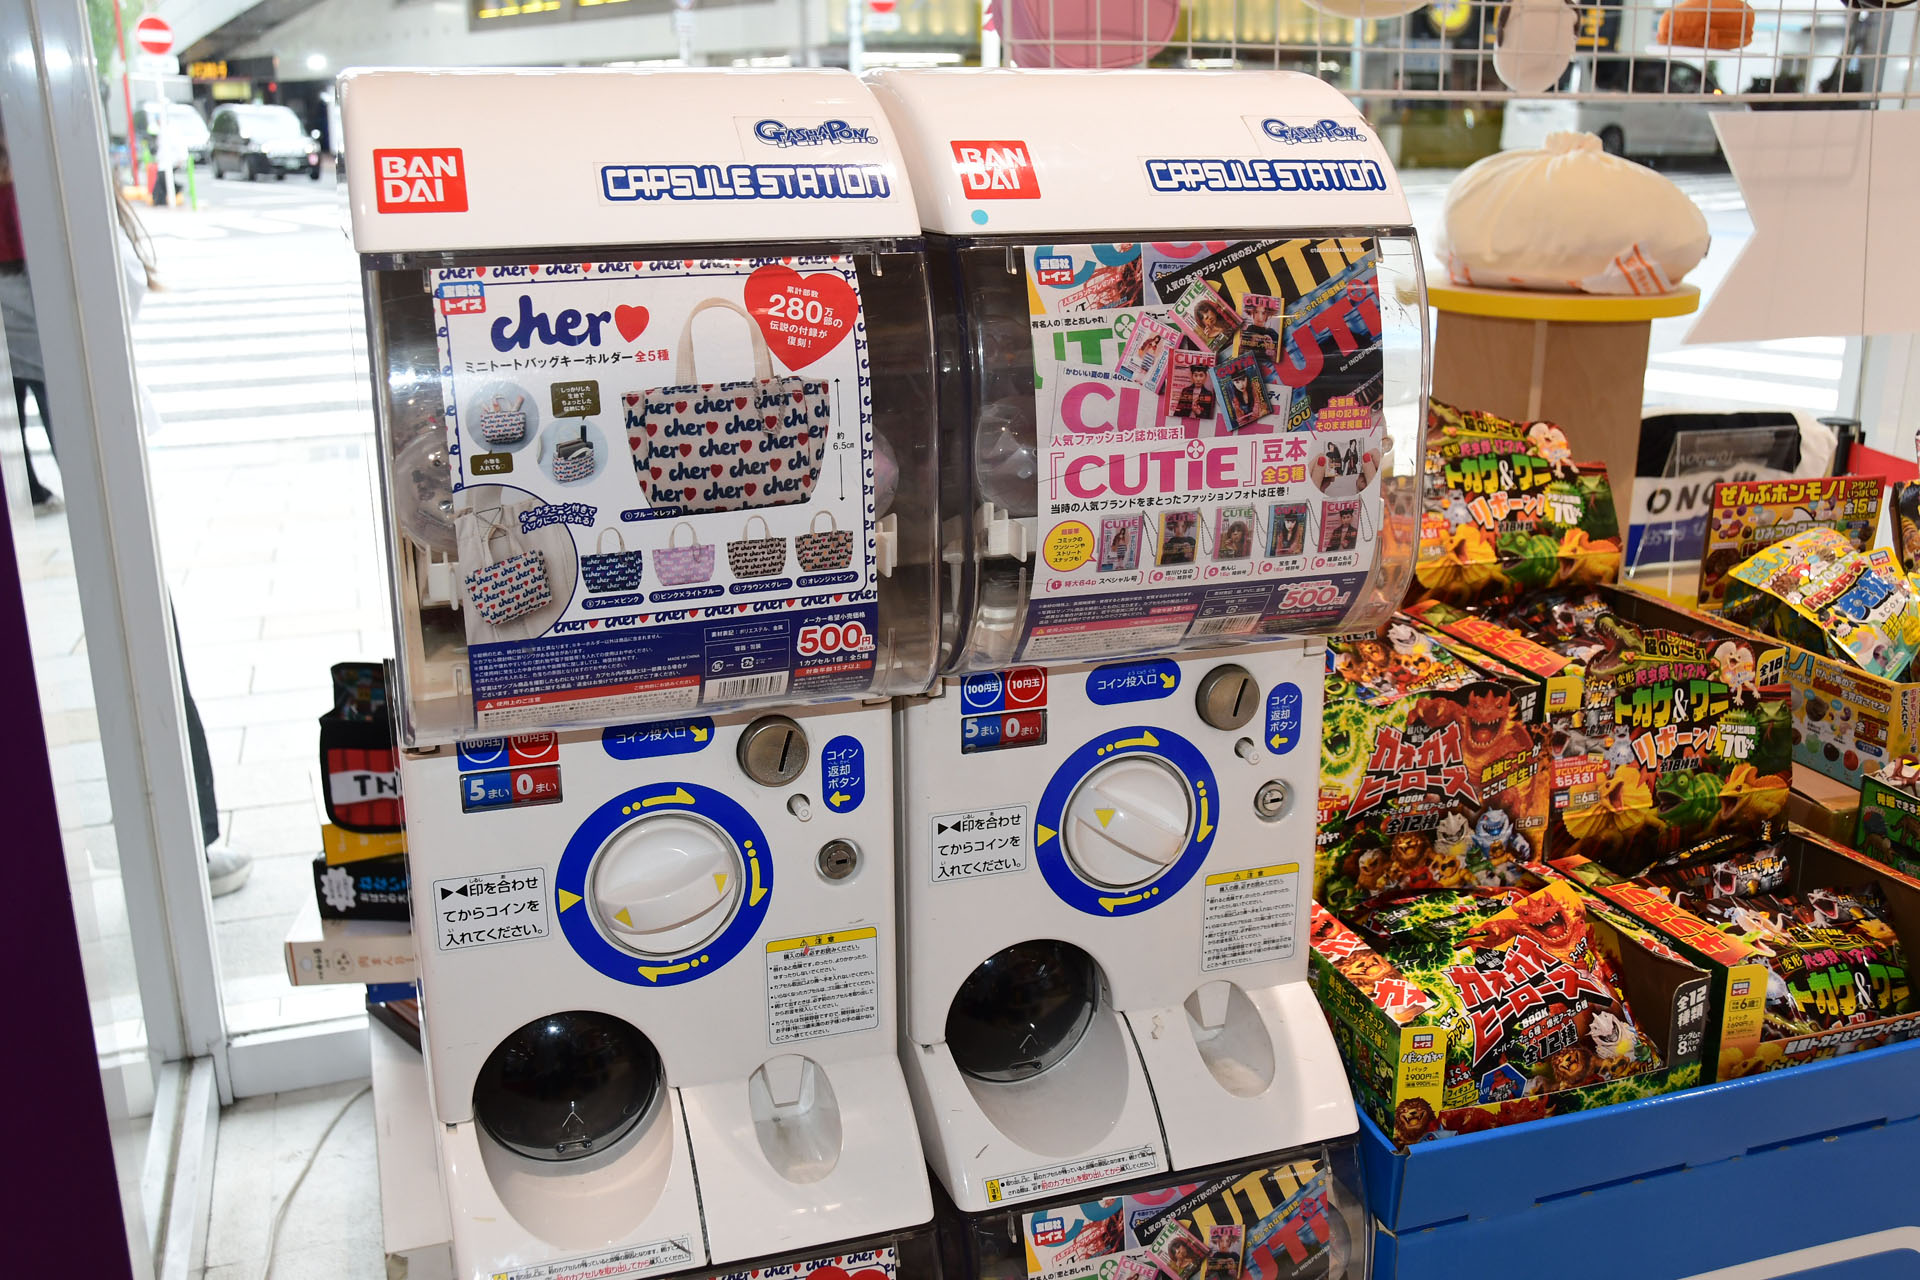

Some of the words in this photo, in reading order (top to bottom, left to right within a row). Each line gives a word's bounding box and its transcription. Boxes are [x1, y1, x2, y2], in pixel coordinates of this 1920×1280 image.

[382, 156, 457, 177] BAN
[959, 148, 1030, 168] BAN
[605, 167, 751, 197] CAPSULE
[756, 166, 889, 197] STATION
[967, 170, 1021, 190] DAI
[1150, 160, 1273, 190] CAPSULE
[1279, 159, 1387, 189] STATION
[385, 180, 444, 203] DAI
[1039, 258, 1070, 269] 宝島社
[1041, 271, 1072, 282] トイズ
[787, 286, 819, 298] 累計部数
[444, 300, 482, 312] トイズ
[768, 294, 822, 323] 280
[491, 295, 611, 352] cher
[770, 321, 828, 339] 伝説の付録が
[1032, 317, 1108, 328] 有名人の「恋とおしゃれ」
[787, 335, 812, 348] 復刻!
[465, 349, 669, 373] ミニトートバッグキーホルダー全5種
[695, 396, 734, 412] cher
[1320, 408, 1369, 419] 当時の記事が
[664, 419, 705, 437] cher
[725, 415, 763, 434] cher
[759, 434, 797, 452] cher
[1052, 428, 1183, 447] 人気ファッション誌が復活!
[699, 438, 740, 457] cher
[1262, 437, 1307, 463] 豆本
[669, 457, 710, 481] cher
[730, 459, 769, 477] cher
[1262, 465, 1306, 484] 全5種
[704, 482, 744, 500] cher
[763, 476, 802, 496] cher
[1721, 480, 1844, 506] ぜんぶホンモノ!
[1051, 487, 1290, 514] 当時の人気ブランドをまとったファッションフォトは圧巻!
[1467, 491, 1545, 529] リボーン!
[1844, 500, 1877, 515] 全15種
[519, 505, 596, 523] ボールチェーン付きで
[522, 516, 594, 533] バッグにつけられる!
[1099, 575, 1137, 585] スペシャル号
[803, 612, 866, 624] メーカー希望小売価格
[800, 624, 871, 653] 500円
[967, 682, 999, 694] 100円玉
[1012, 677, 1040, 689] 10円玉
[1098, 674, 1158, 690] コイン投入口
[1271, 694, 1298, 705] コイン
[1615, 679, 1728, 727] トカゲ&ワニ
[1271, 709, 1290, 720] 返却
[616, 727, 685, 744] コイン投入口
[1270, 720, 1298, 732] ボタン
[827, 748, 858, 760] コイン
[1632, 725, 1717, 769] リボーン!
[1721, 735, 1755, 758] 70%
[828, 765, 851, 777] 返却
[1481, 743, 1542, 784] 最強ヒーローが
[828, 777, 860, 789] ボタン
[1481, 763, 1539, 799] ここに誕生!!
[1555, 773, 1594, 787] もらえる!
[1345, 765, 1481, 821] ヒーローズ
[962, 813, 1021, 832] 印を合わせ
[938, 836, 1020, 856] てからコインを
[938, 859, 1022, 878] 入れてください。
[469, 876, 538, 897] 印を合わせ
[443, 901, 539, 923] てからコインを
[446, 926, 543, 946] 入れてください。
[1677, 986, 1707, 1011] 全12
[1786, 963, 1910, 1015] トカゲ&ワニ
[1469, 963, 1613, 1068] ヒーローズ
[1677, 1008, 1704, 1028] 種類
[1401, 1052, 1444, 1064] パックガチャ
[806, 1258, 833, 1271] cher
[847, 1252, 875, 1264] cher
[764, 1264, 792, 1277] cher
